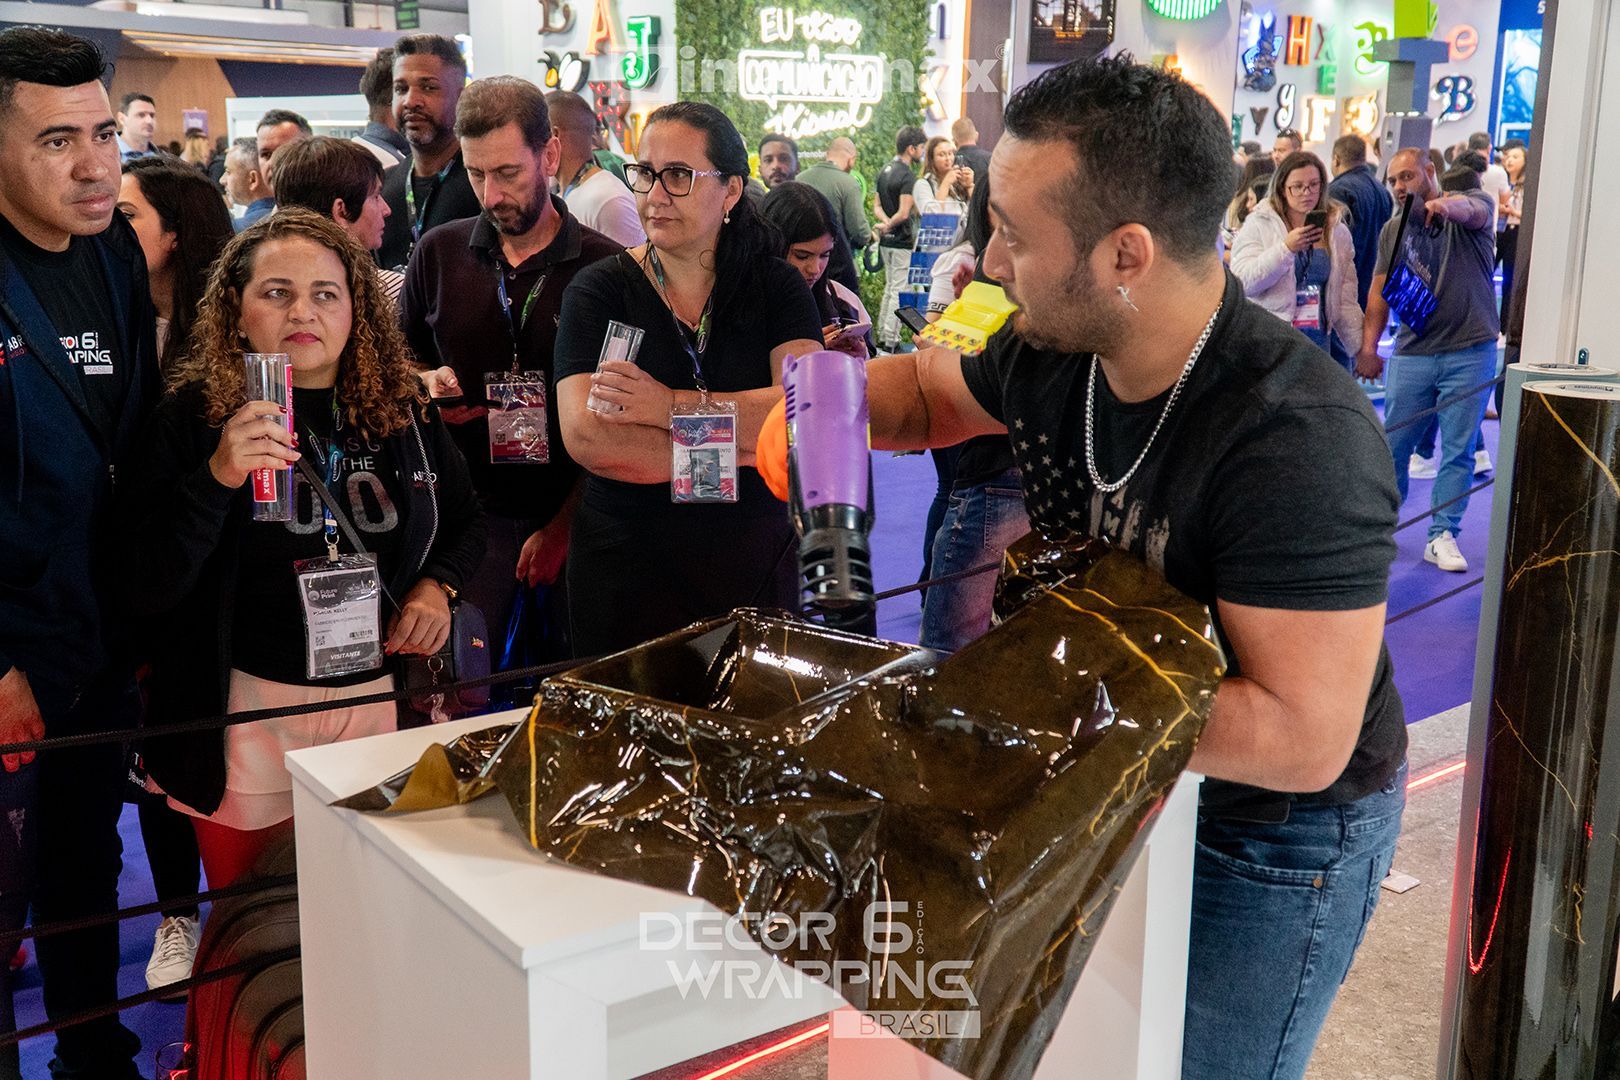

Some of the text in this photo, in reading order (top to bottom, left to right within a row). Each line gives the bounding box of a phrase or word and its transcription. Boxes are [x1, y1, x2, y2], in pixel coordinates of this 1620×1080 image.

[760, 7, 794, 43] EU
[1284, 15, 1313, 66] H
[1318, 64, 1337, 95] E
[1431, 75, 1478, 127] B
